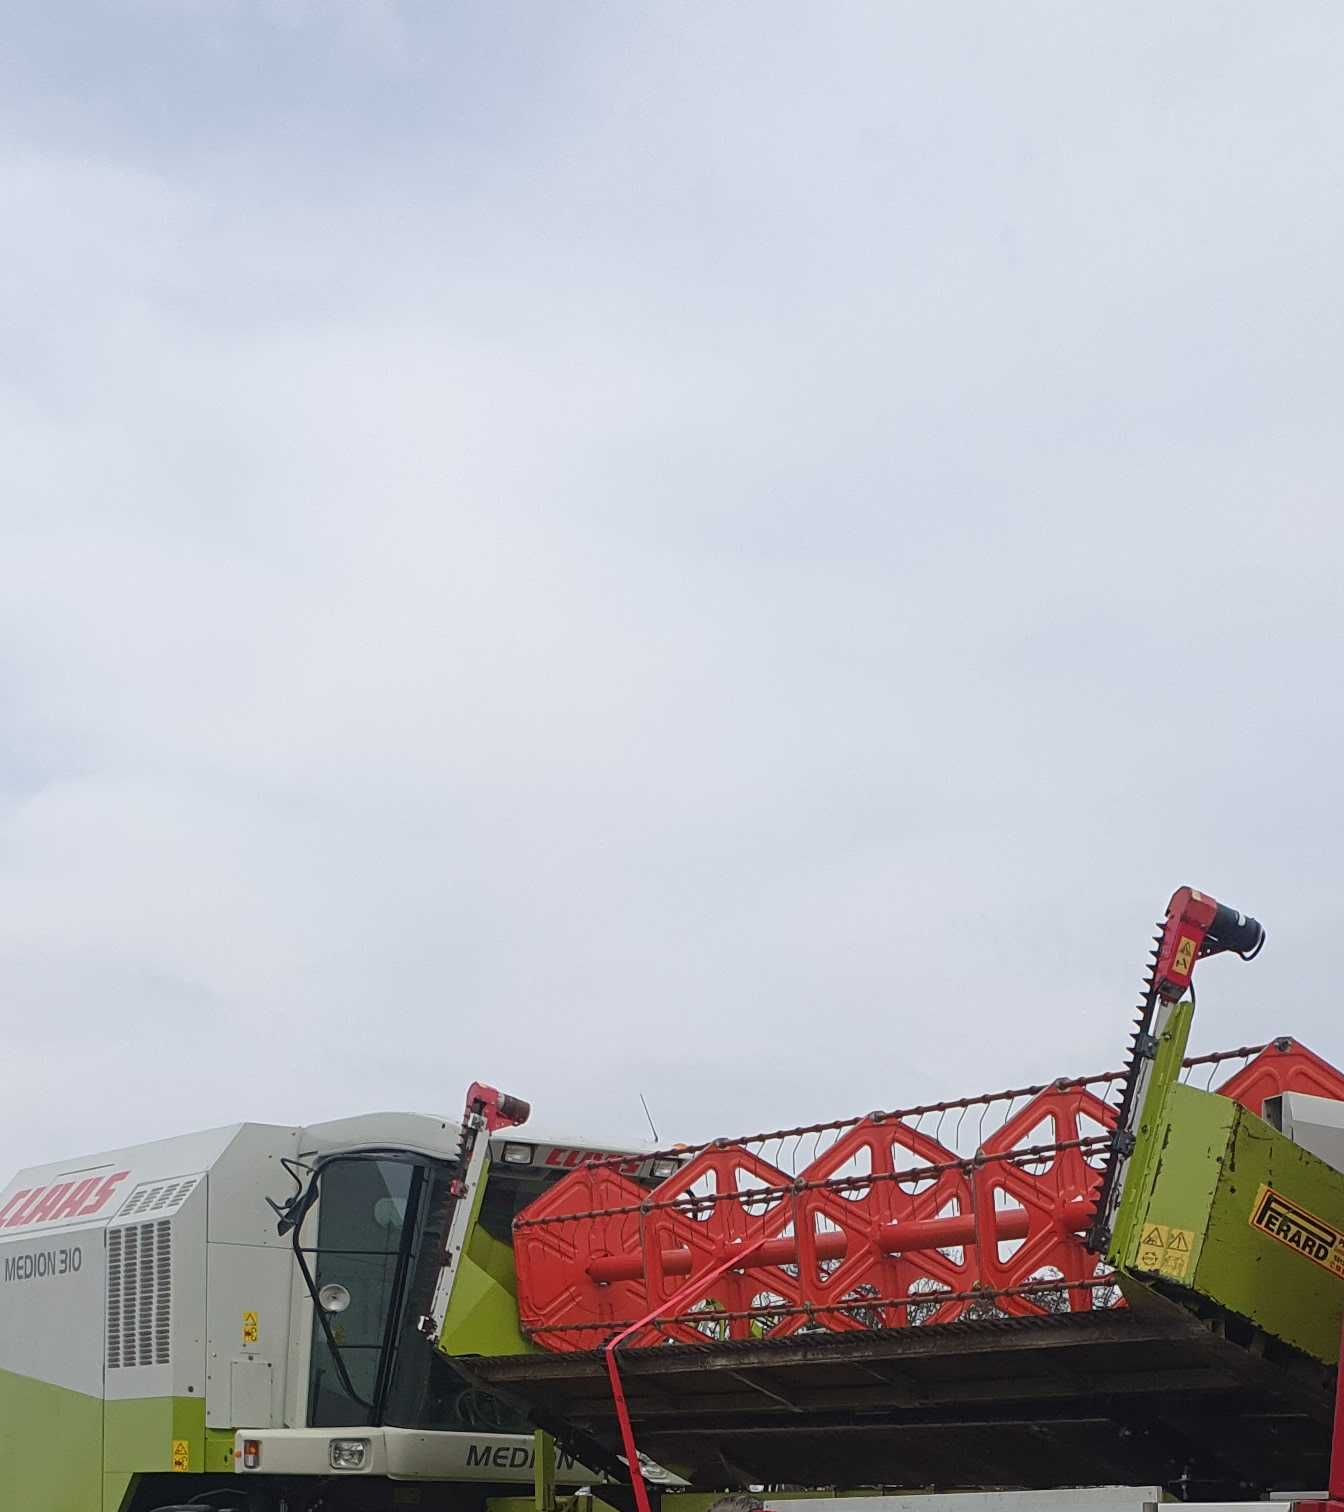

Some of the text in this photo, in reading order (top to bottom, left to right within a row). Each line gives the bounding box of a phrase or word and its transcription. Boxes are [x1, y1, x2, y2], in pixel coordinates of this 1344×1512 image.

[5, 1247, 82, 1282] MEDION 310
[465, 1444, 575, 1470] MEDIN
